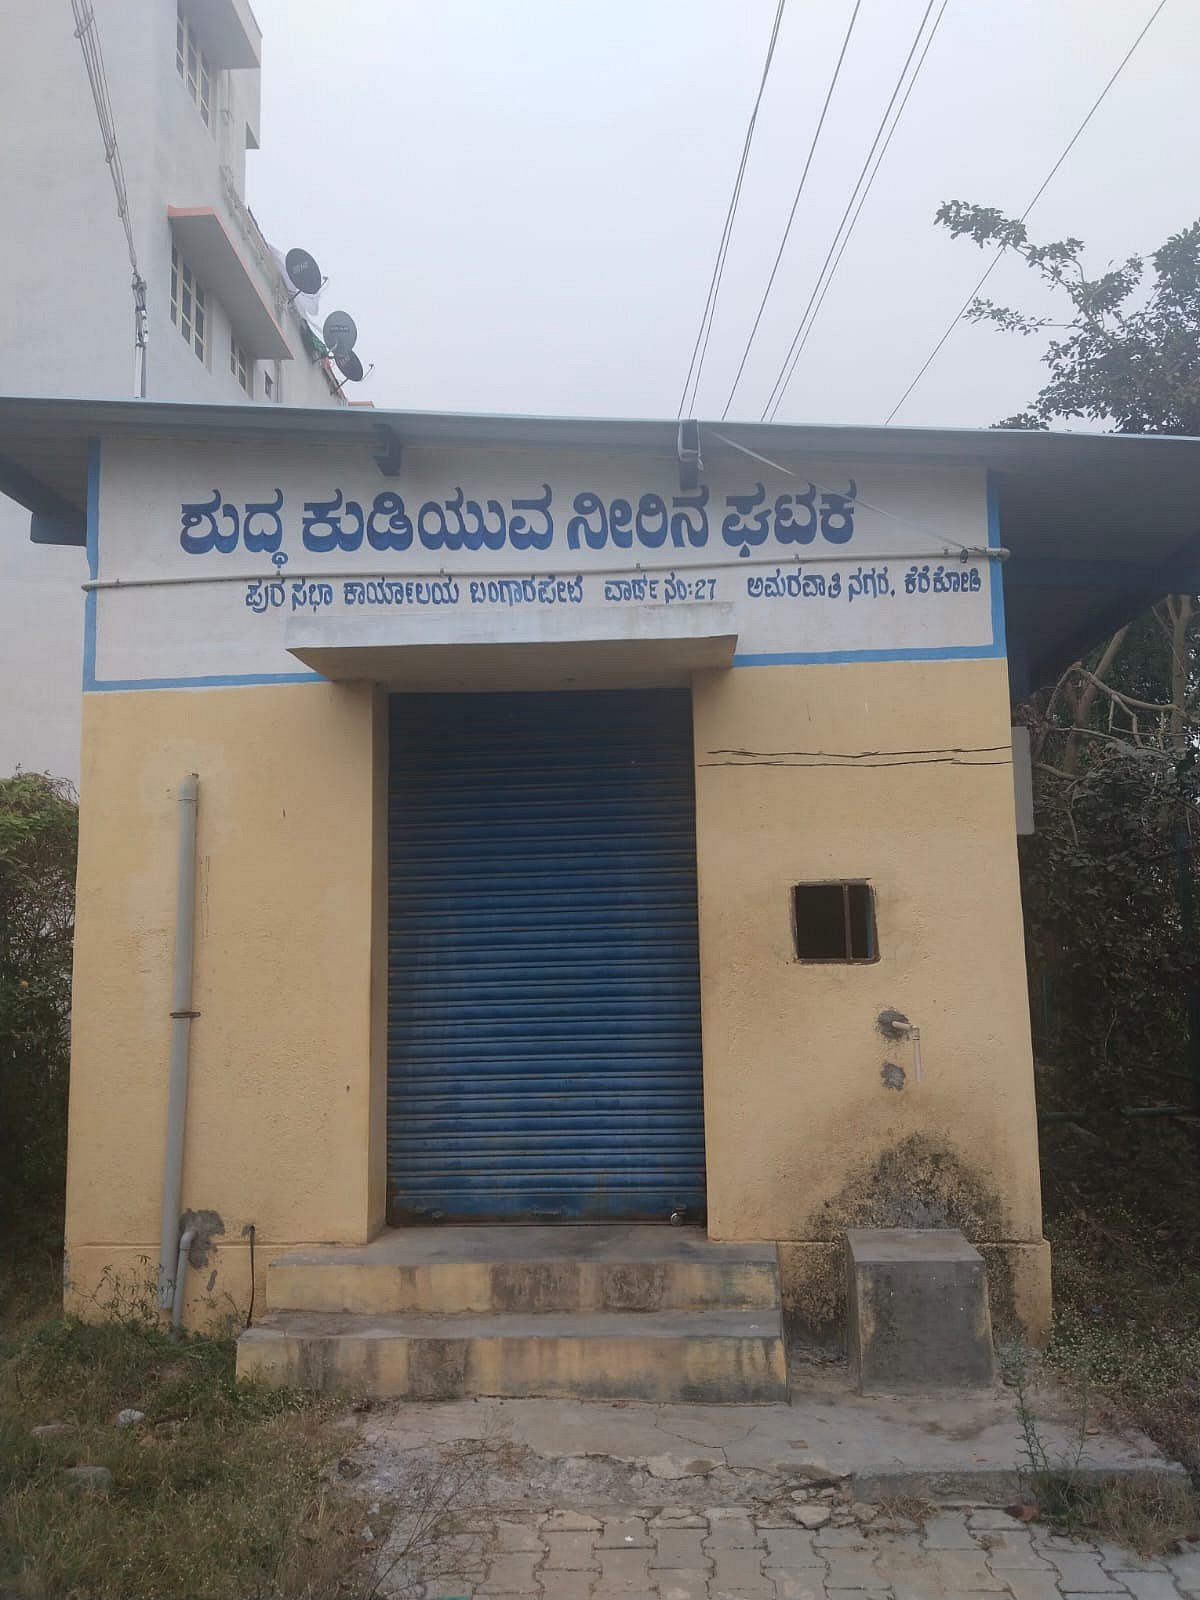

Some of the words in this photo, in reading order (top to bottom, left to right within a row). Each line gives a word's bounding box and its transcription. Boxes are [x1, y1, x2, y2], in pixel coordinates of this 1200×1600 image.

[179, 488, 289, 569] ಶುದ್ಧ
[301, 483, 554, 553] ಕುಡಿಯುವ
[566, 484, 710, 550] ನೀರಿನ
[721, 478, 857, 558] ಘಟಕ
[469, 575, 584, 607] ಬಂಗಾರಪೇಟೆ
